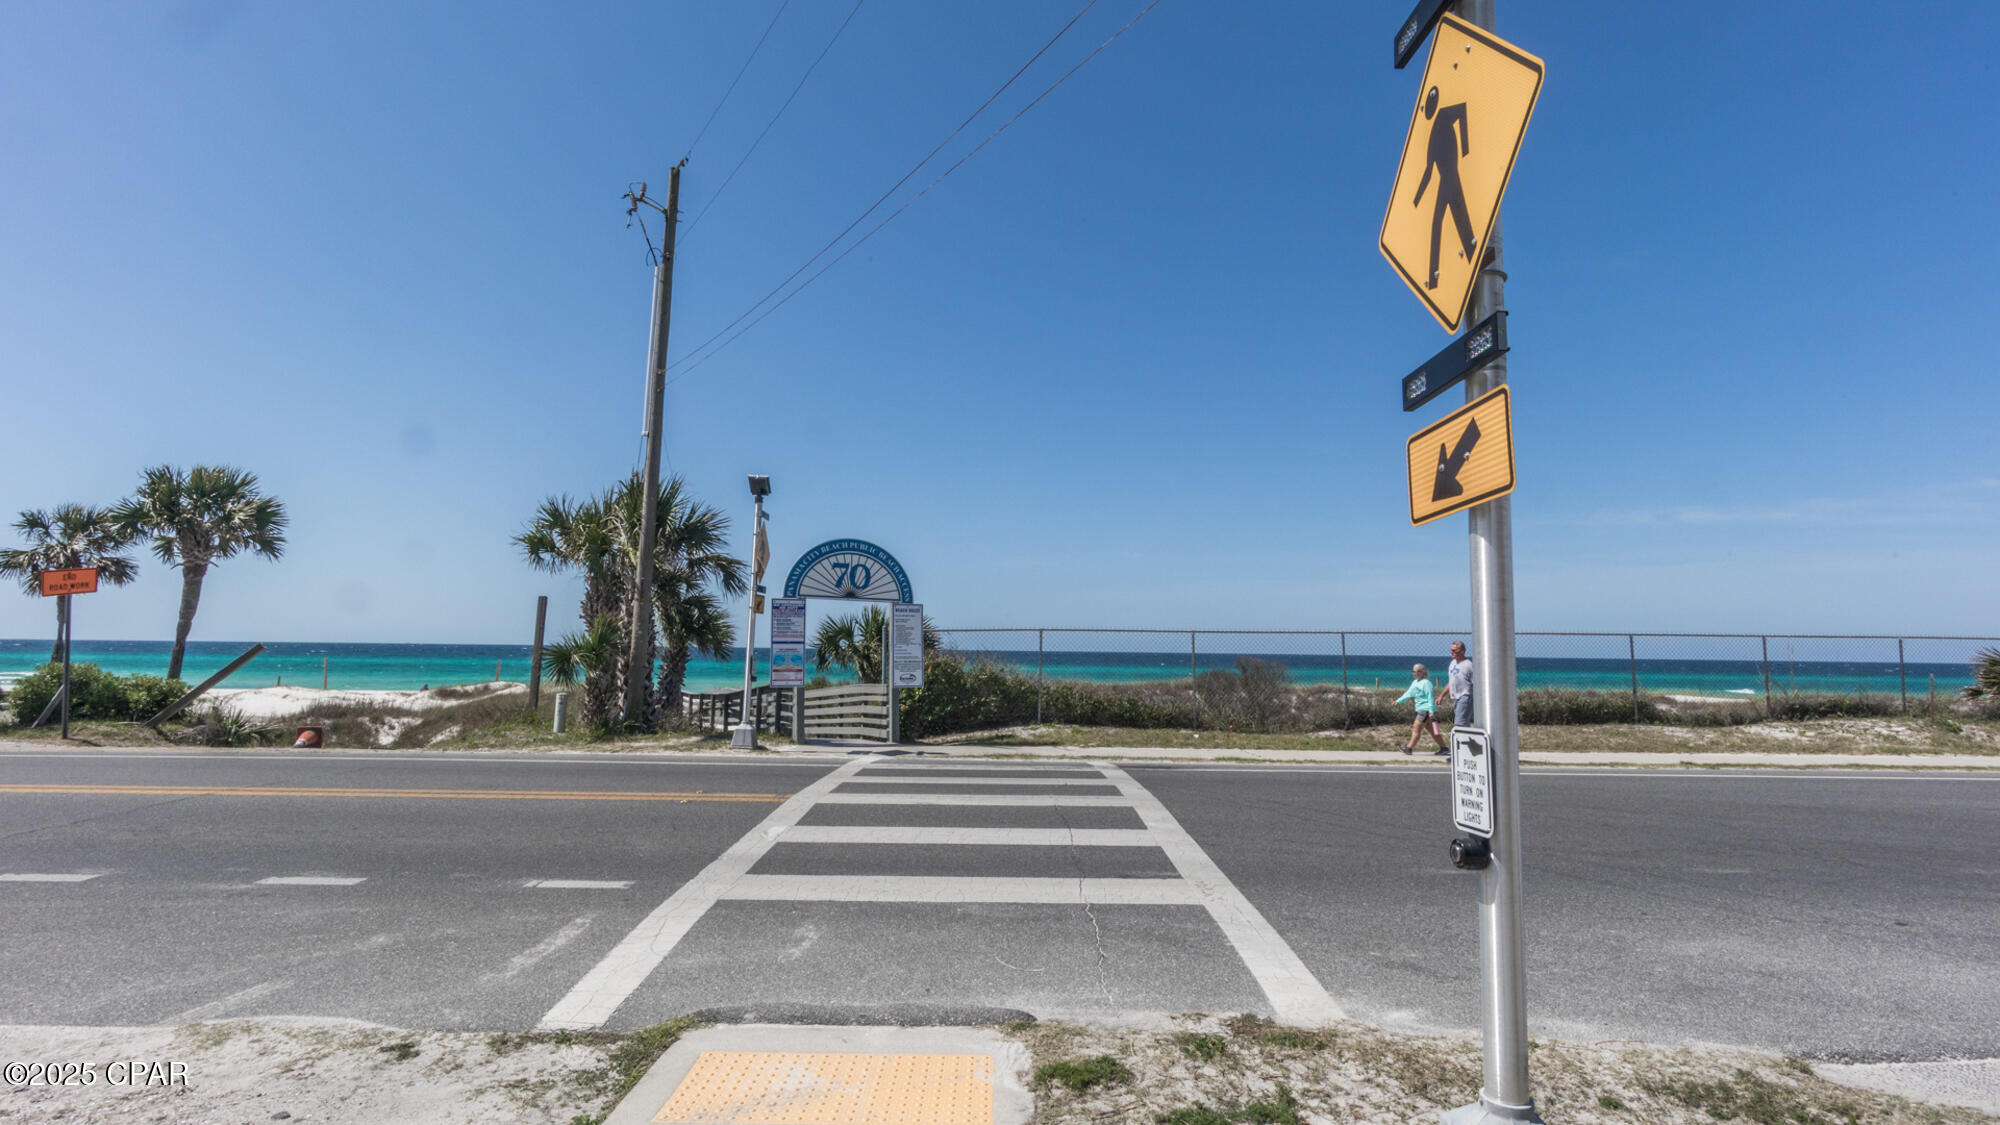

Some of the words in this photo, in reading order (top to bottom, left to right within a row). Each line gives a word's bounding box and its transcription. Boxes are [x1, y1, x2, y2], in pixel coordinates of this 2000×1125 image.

[62, 571, 77, 580] END
[786, 563, 806, 597] PANAMA
[803, 549, 820, 565] CITY
[820, 541, 848, 553] BEACH
[849, 541, 876, 554] PUBLIC
[878, 551, 900, 573] BEACH
[832, 562, 871, 590] 70
[49, 583, 69, 591] ROAD
[1463, 758, 1477, 770] PUSH
[1457, 770, 1475, 783] BUTTON
[1478, 774, 1485, 786] TO
[1460, 783, 1473, 795] TURN
[1476, 787, 1484, 798] ON
[1461, 798, 1483, 812] WARNING
[1463, 811, 1481, 825] LIGHTS
